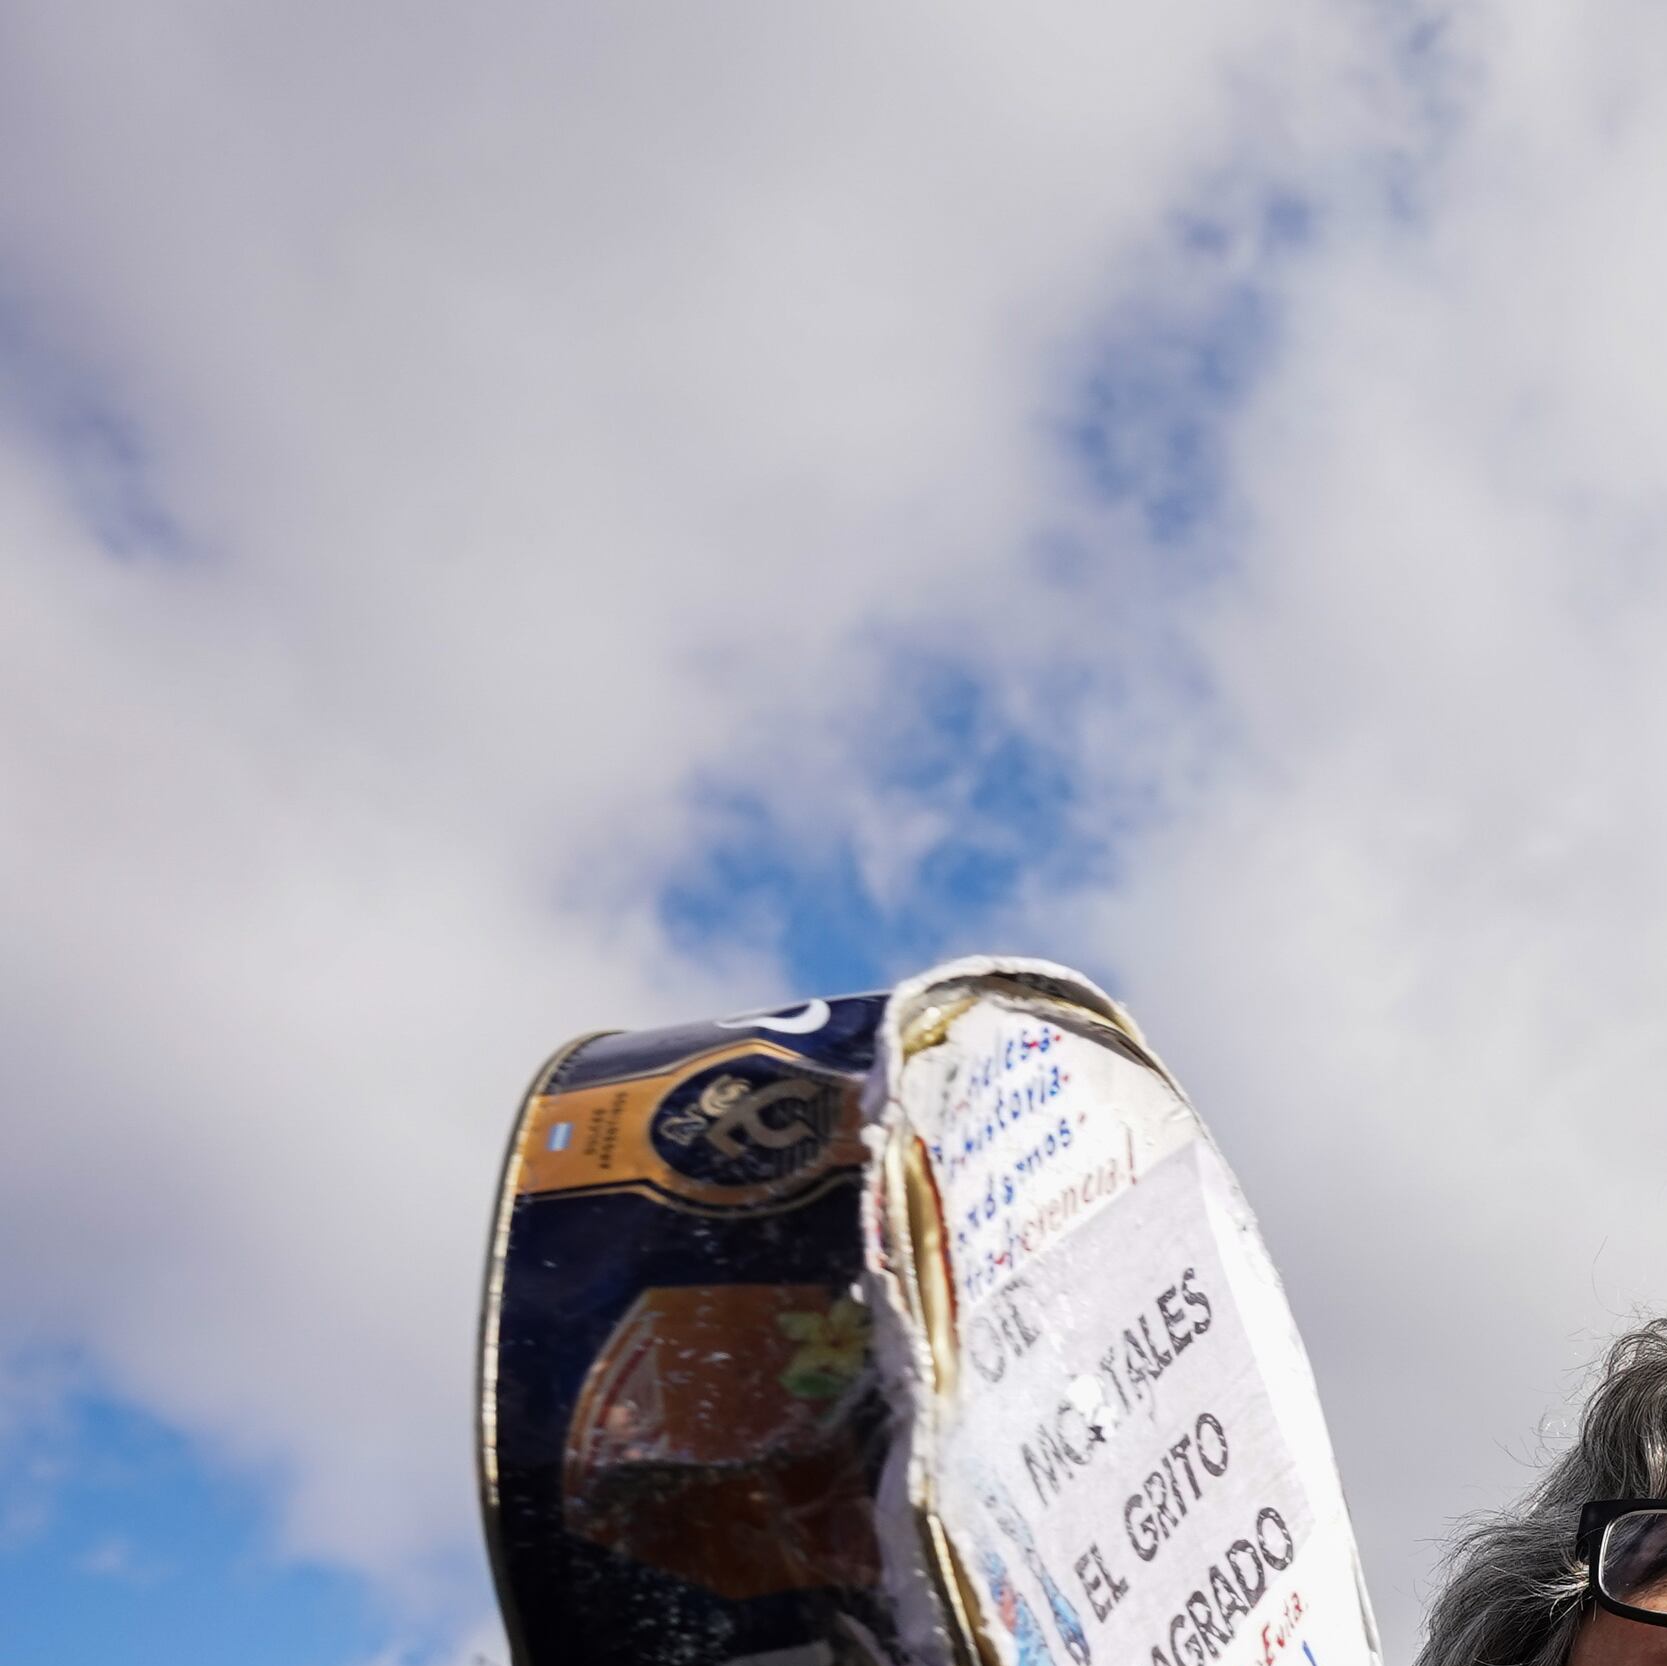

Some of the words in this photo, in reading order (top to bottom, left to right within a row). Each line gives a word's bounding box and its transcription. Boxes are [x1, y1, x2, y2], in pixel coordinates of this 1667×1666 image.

[1020, 1268, 1212, 1508] MOTALES
[1074, 1543, 1130, 1623] EL
[1124, 1413, 1229, 1562] GRITO
